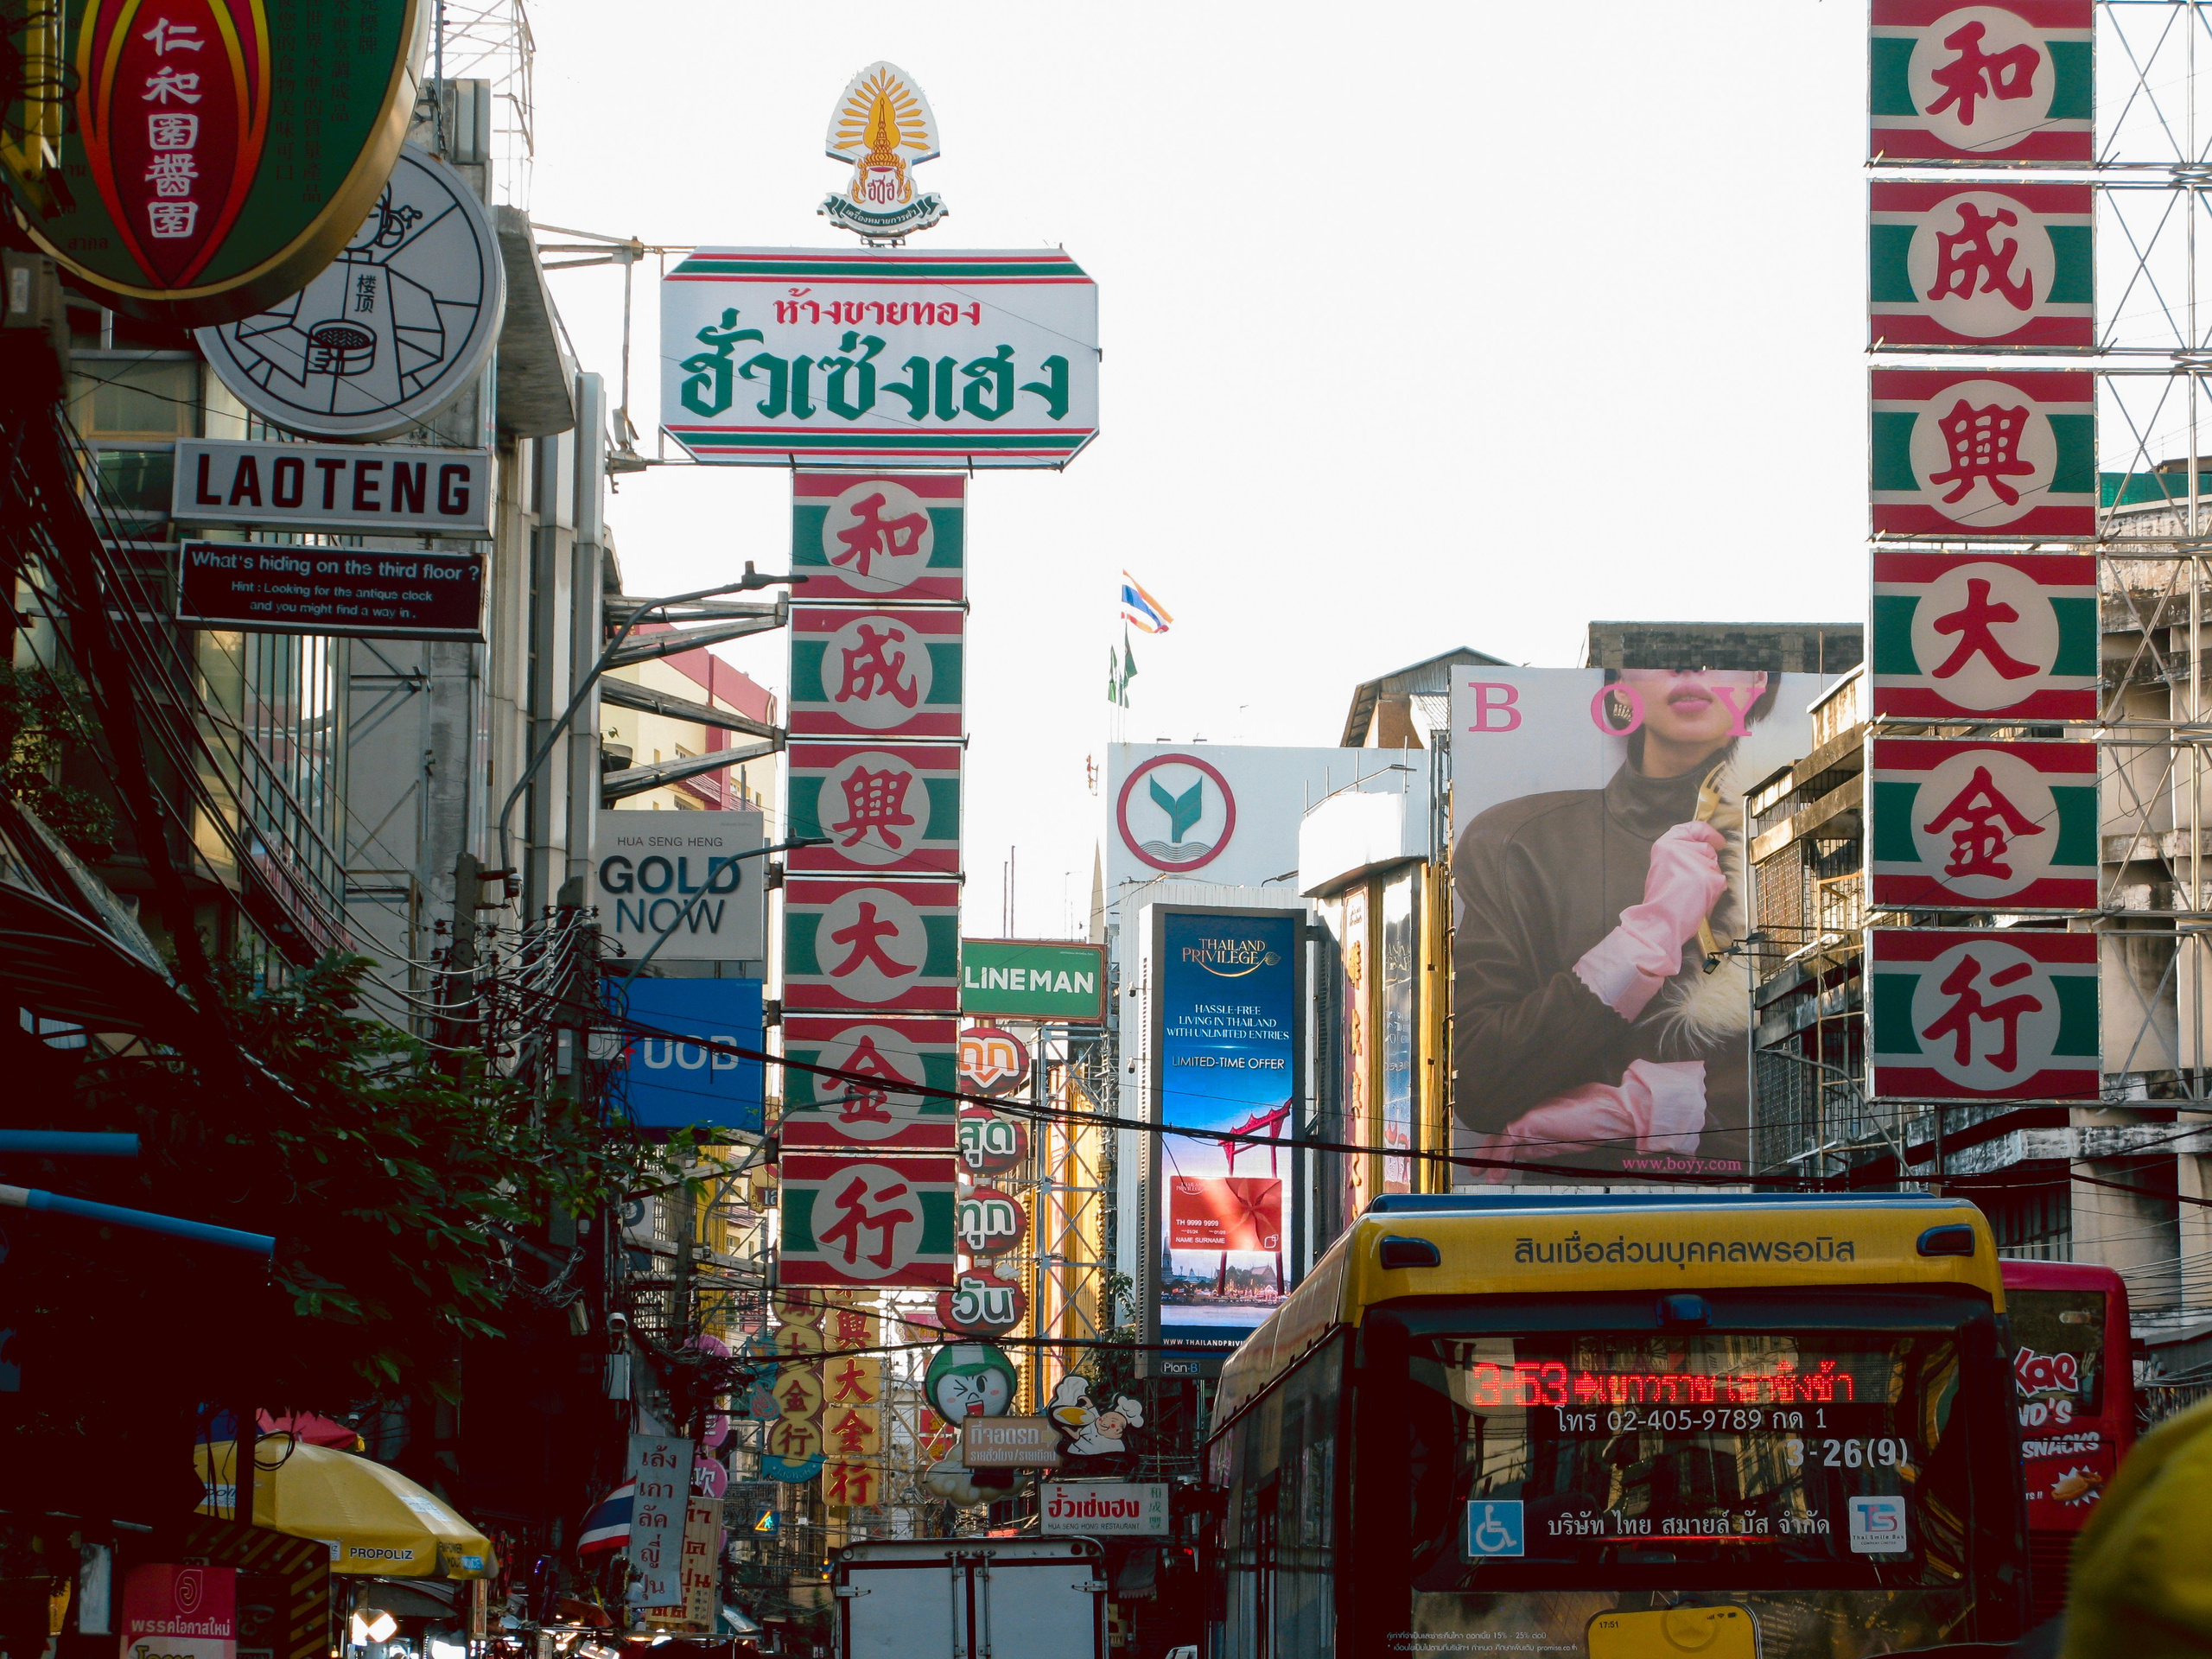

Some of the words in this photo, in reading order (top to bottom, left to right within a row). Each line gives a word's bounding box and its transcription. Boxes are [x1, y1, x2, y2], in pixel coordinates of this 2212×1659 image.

[354, 274, 377, 314] 楼顶
[773, 288, 982, 327] ห้างขายทอง
[680, 308, 1070, 422] ฮั่วเซ่งเฮง
[195, 454, 471, 516] LAOTENG
[191, 550, 254, 570] What's
[259, 556, 311, 576] hiding
[316, 562, 338, 573] on
[345, 559, 372, 575] the
[378, 561, 417, 579] third
[423, 563, 463, 581] floor
[232, 582, 254, 593] Hint
[264, 583, 310, 597] Looking
[314, 585, 330, 596] for
[334, 587, 353, 597] the
[356, 588, 397, 601] antique
[401, 590, 433, 601] clock
[250, 601, 272, 612] and
[276, 603, 297, 613] you
[300, 603, 333, 616] might
[336, 604, 359, 616] find
[361, 607, 369, 616] a
[372, 608, 397, 620] way
[399, 608, 410, 619] in
[617, 836, 644, 847] HUA
[648, 836, 683, 847] SENG
[688, 836, 723, 847] HENG
[599, 855, 741, 894] GOLD
[616, 898, 725, 934] NOW
[1182, 947, 1260, 965] PRIVILEGE
[1198, 938, 1267, 951] THAILAND
[965, 966, 1025, 991] LINE
[1030, 968, 1094, 994] MAN
[1179, 1015, 1212, 1026] LIVING
[1214, 1017, 1224, 1027] IN
[1226, 1017, 1277, 1027] THAILAND
[1195, 1004, 1262, 1015] HASSLE-FREE
[1166, 1027, 1192, 1037] WITH
[1194, 1028, 1247, 1039] UNLIMITED
[1249, 1030, 1290, 1040] ENTRIES
[643, 1034, 740, 1071] UOB
[1173, 1056, 1245, 1069] LIMITED-TIME
[1249, 1058, 1285, 1070] OFFER
[1622, 1156, 1742, 1174] www.boyy.com
[1514, 1230, 1856, 1271] สินเชื่อส่วนบุคคลพรอมิส
[1474, 1363, 1567, 1407] 3-53
[1554, 1404, 1596, 1432] โทร
[1607, 1409, 1762, 1432] 02-405-9789
[1772, 1412, 1804, 1430] กด
[1816, 1408, 1827, 1429] 1
[970, 1421, 1039, 1446] ที่จอดรถ
[2022, 1431, 2101, 1459] SNACKS
[639, 1482, 674, 1499] เกา
[1548, 1510, 1605, 1535] บริษัท
[1611, 1510, 1652, 1535] ไทย
[1662, 1510, 1731, 1535] สมายล์
[1740, 1510, 1769, 1535] บัส
[1777, 1510, 1831, 1535] จำกัด
[349, 1547, 414, 1560] PROPOLIZ
[131, 1615, 231, 1637] พรรคโอกาสใหม่
[1536, 1643, 1578, 1652] promise.co.th
